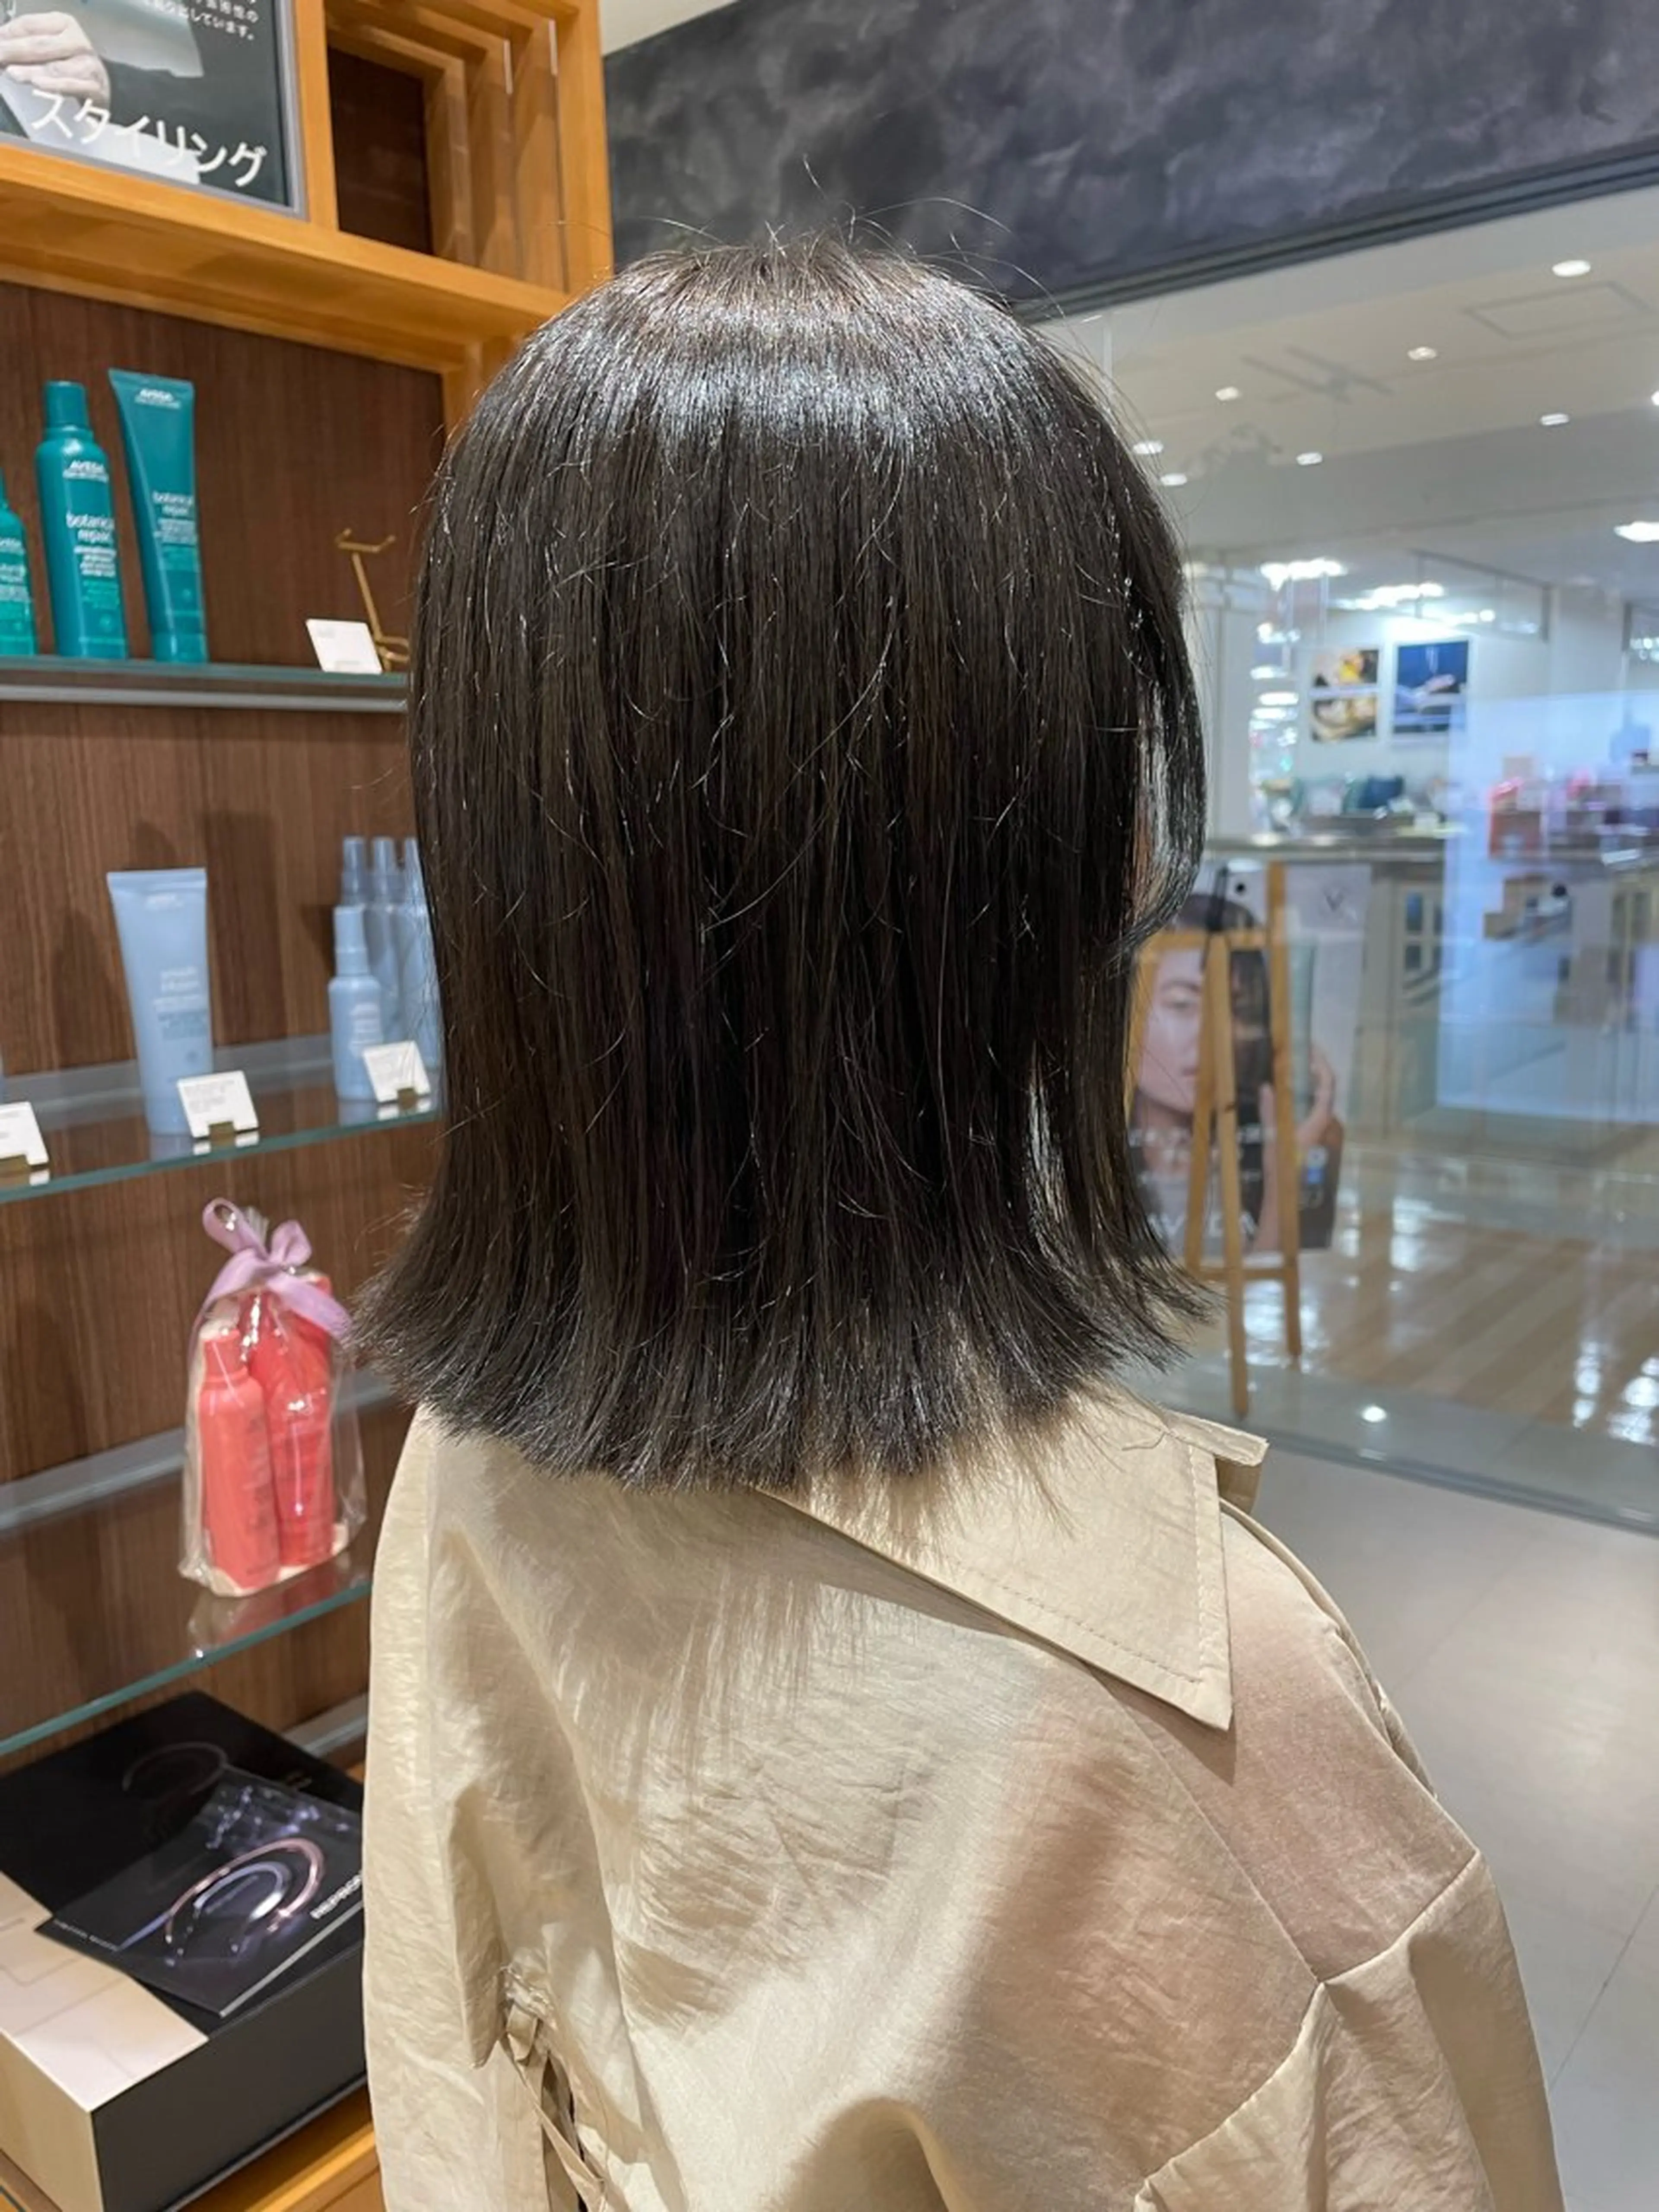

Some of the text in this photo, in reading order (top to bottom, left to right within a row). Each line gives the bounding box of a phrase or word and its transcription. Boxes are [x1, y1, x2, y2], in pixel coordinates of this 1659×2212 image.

[32, 89, 267, 187] スタイリング
